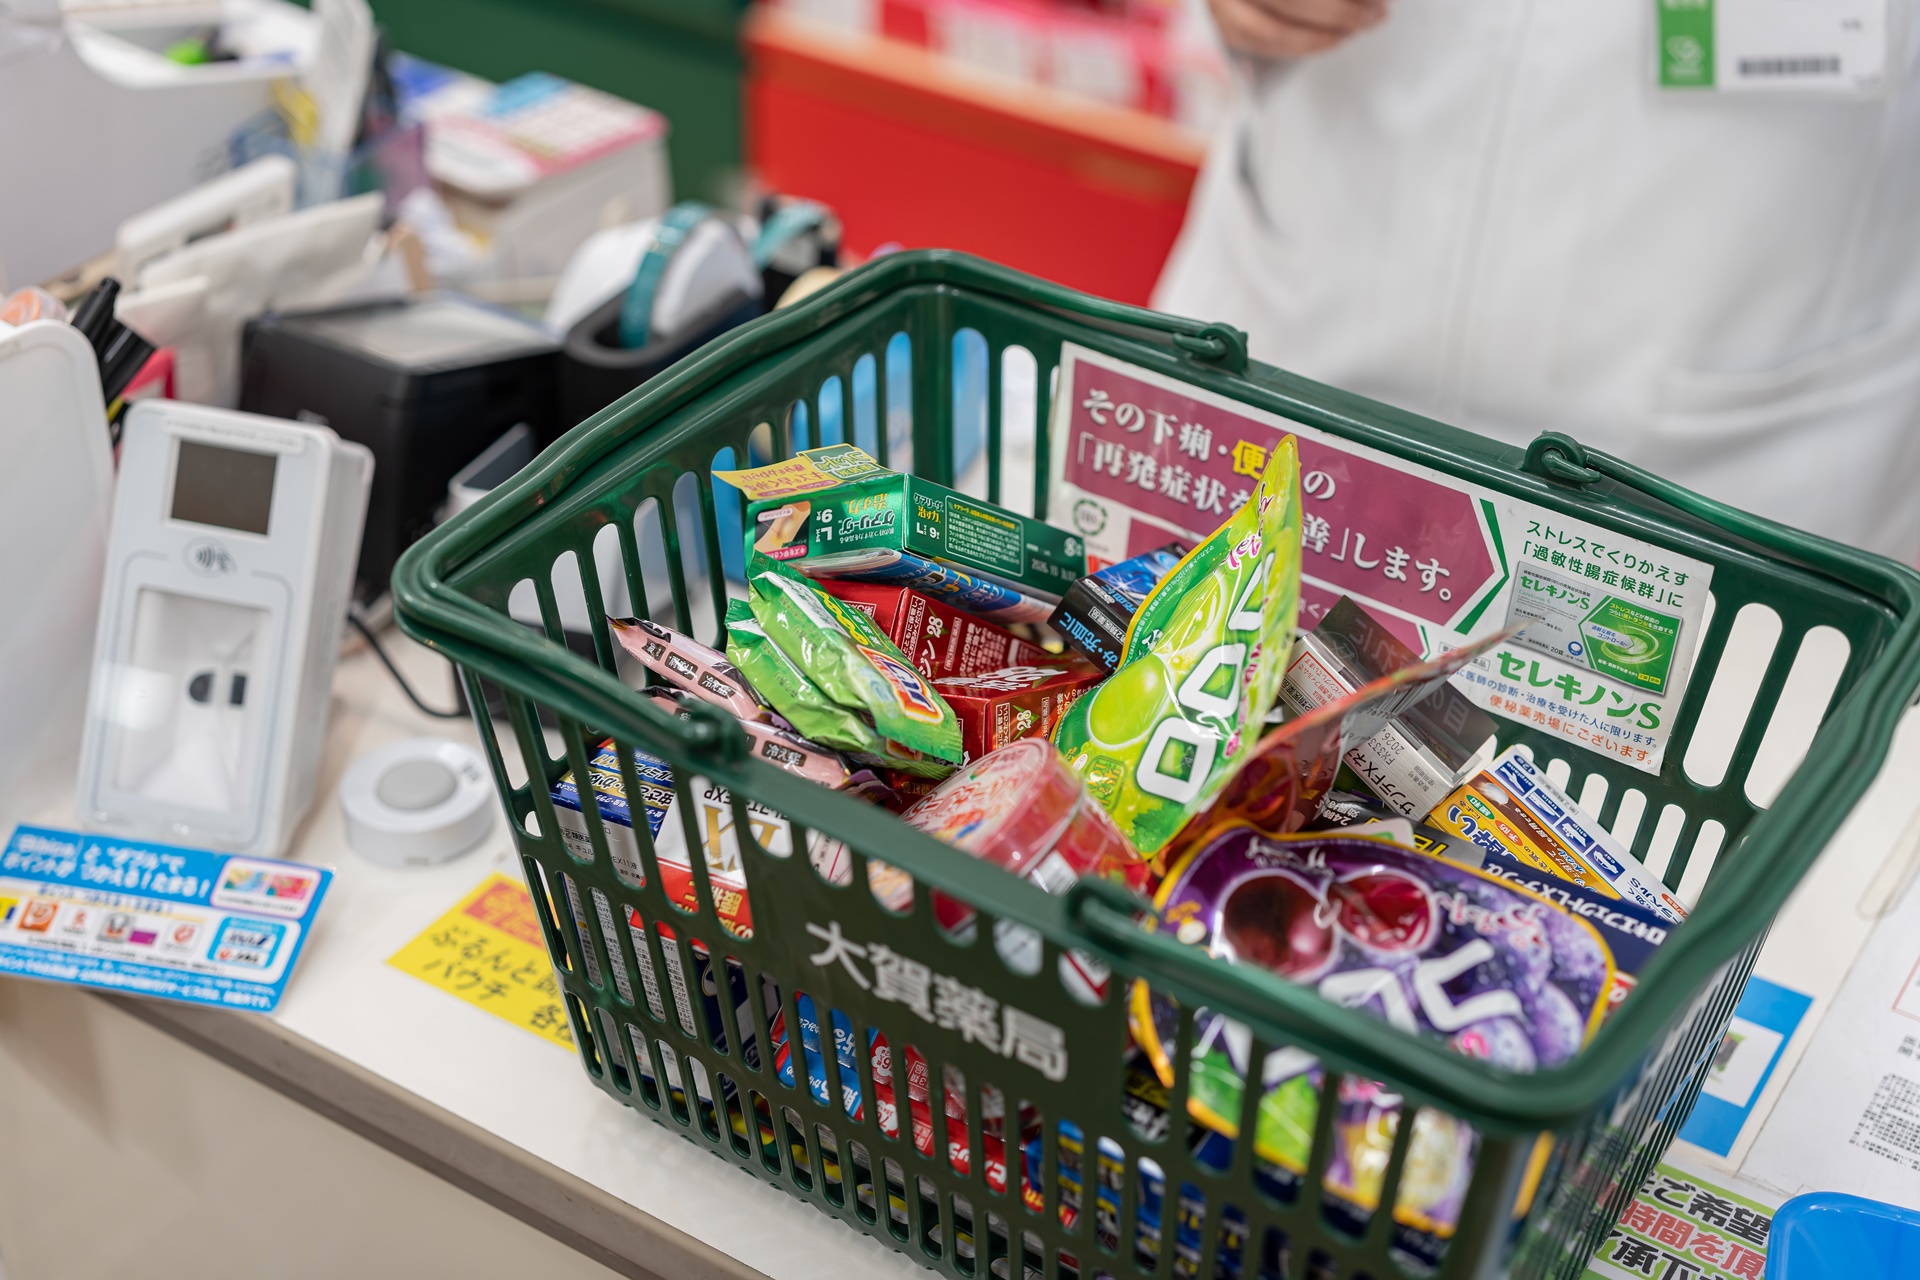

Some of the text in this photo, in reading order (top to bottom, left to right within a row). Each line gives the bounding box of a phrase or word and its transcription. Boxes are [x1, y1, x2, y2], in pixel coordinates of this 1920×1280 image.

[1082, 389, 1336, 499] その下痢・便の
[822, 509, 833, 522] 9
[1077, 431, 1452, 602] 「再発症状を善」します。
[1527, 520, 1689, 586] ストレスでくりかえす
[1523, 541, 1684, 608] 「過敏性腸症候群」に
[927, 615, 943, 638] 28
[1056, 610, 1123, 672] み・充血に
[1497, 651, 1662, 730] セレキノンS
[1014, 708, 1034, 732] 28
[1490, 694, 1652, 765] 便秘薬売場にございます。
[766, 743, 801, 765] 冷え症
[1505, 762, 1534, 787] airplane
[1468, 796, 1493, 817] 緩和
[1540, 793, 1560, 810] train
[1319, 806, 1352, 826] 24時
[1442, 803, 1519, 868] 酔い
[1497, 822, 1522, 843] 予防
[1570, 822, 1590, 839] ship
[1602, 852, 1617, 865] car
[806, 920, 1068, 1082] 大賀薬局
